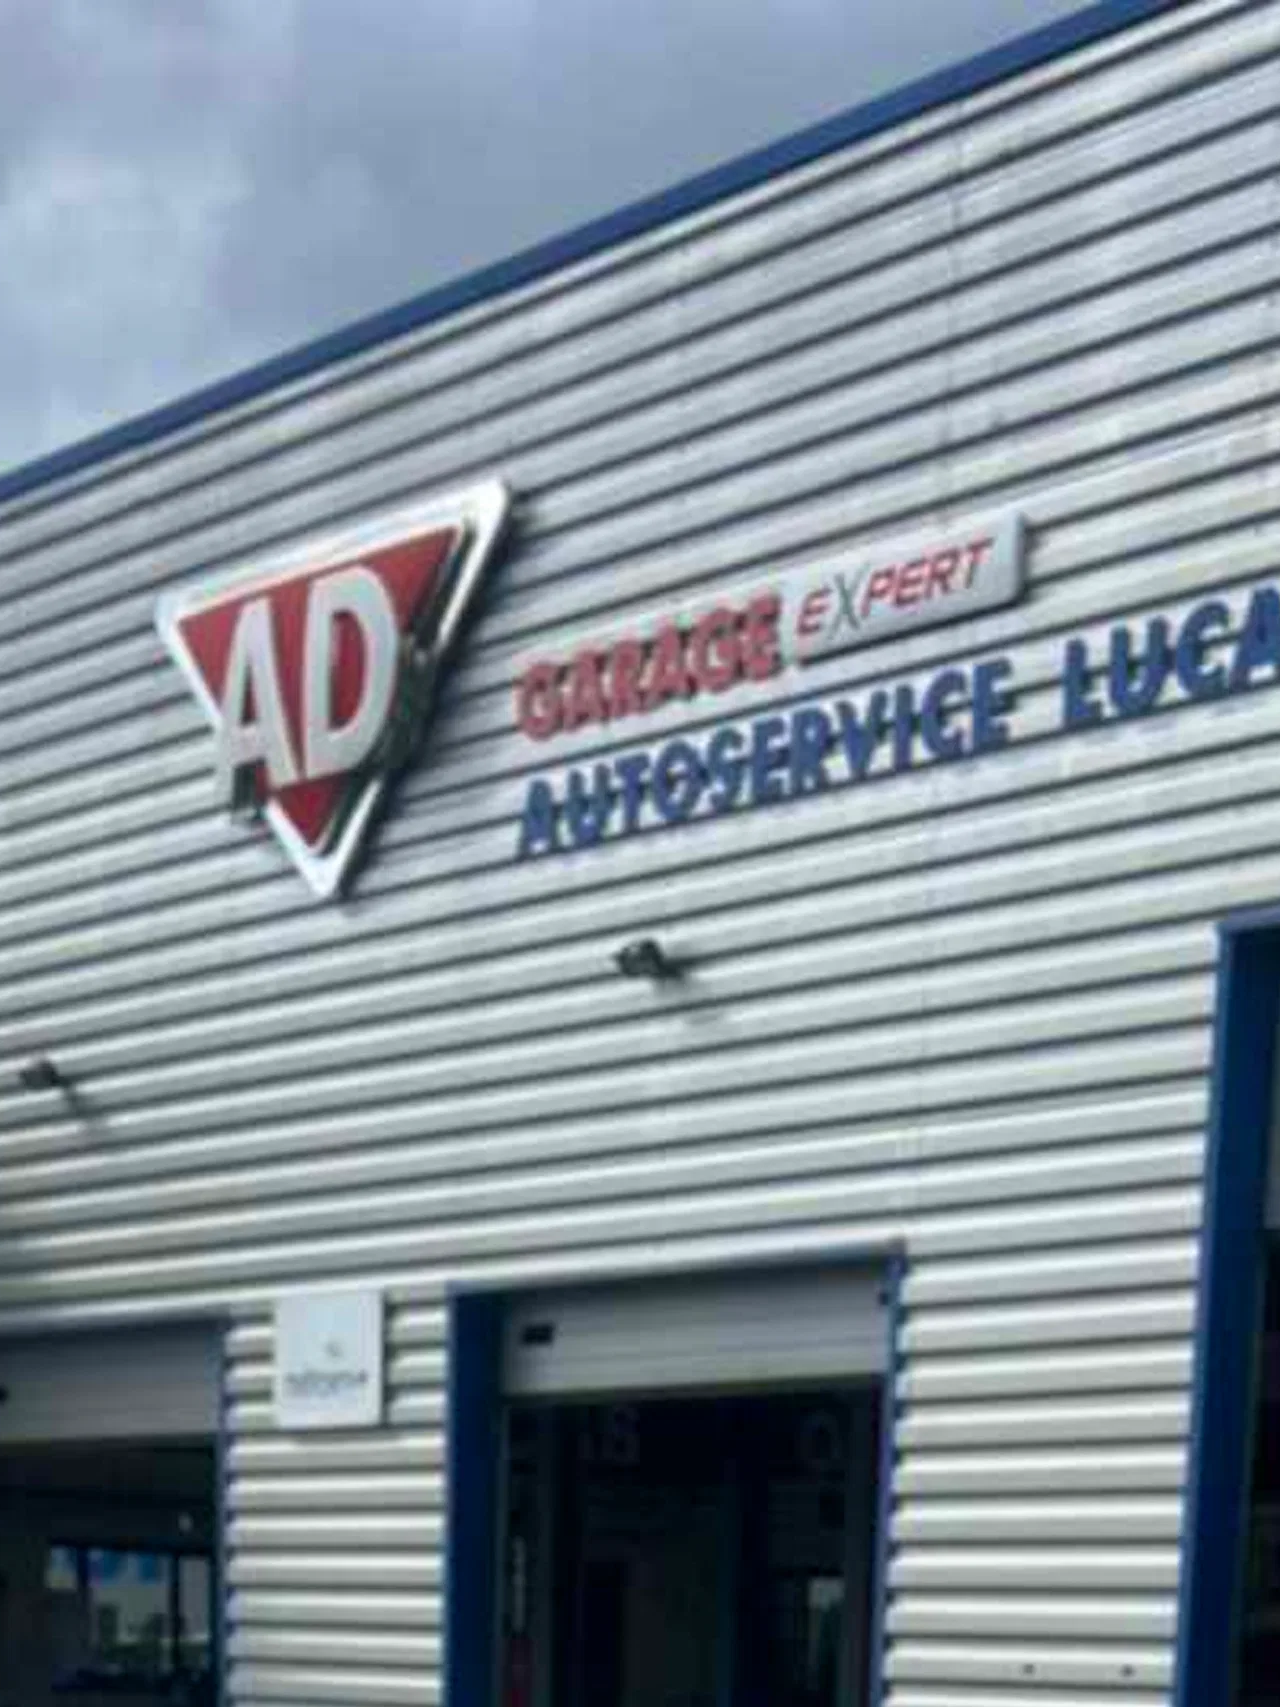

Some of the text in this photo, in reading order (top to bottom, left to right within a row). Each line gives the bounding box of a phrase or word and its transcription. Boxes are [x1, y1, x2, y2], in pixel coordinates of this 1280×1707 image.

[215, 563, 400, 810] AD
[517, 534, 996, 742] GARAGE EXPERT
[519, 656, 1014, 858] AUTOSERVICE
